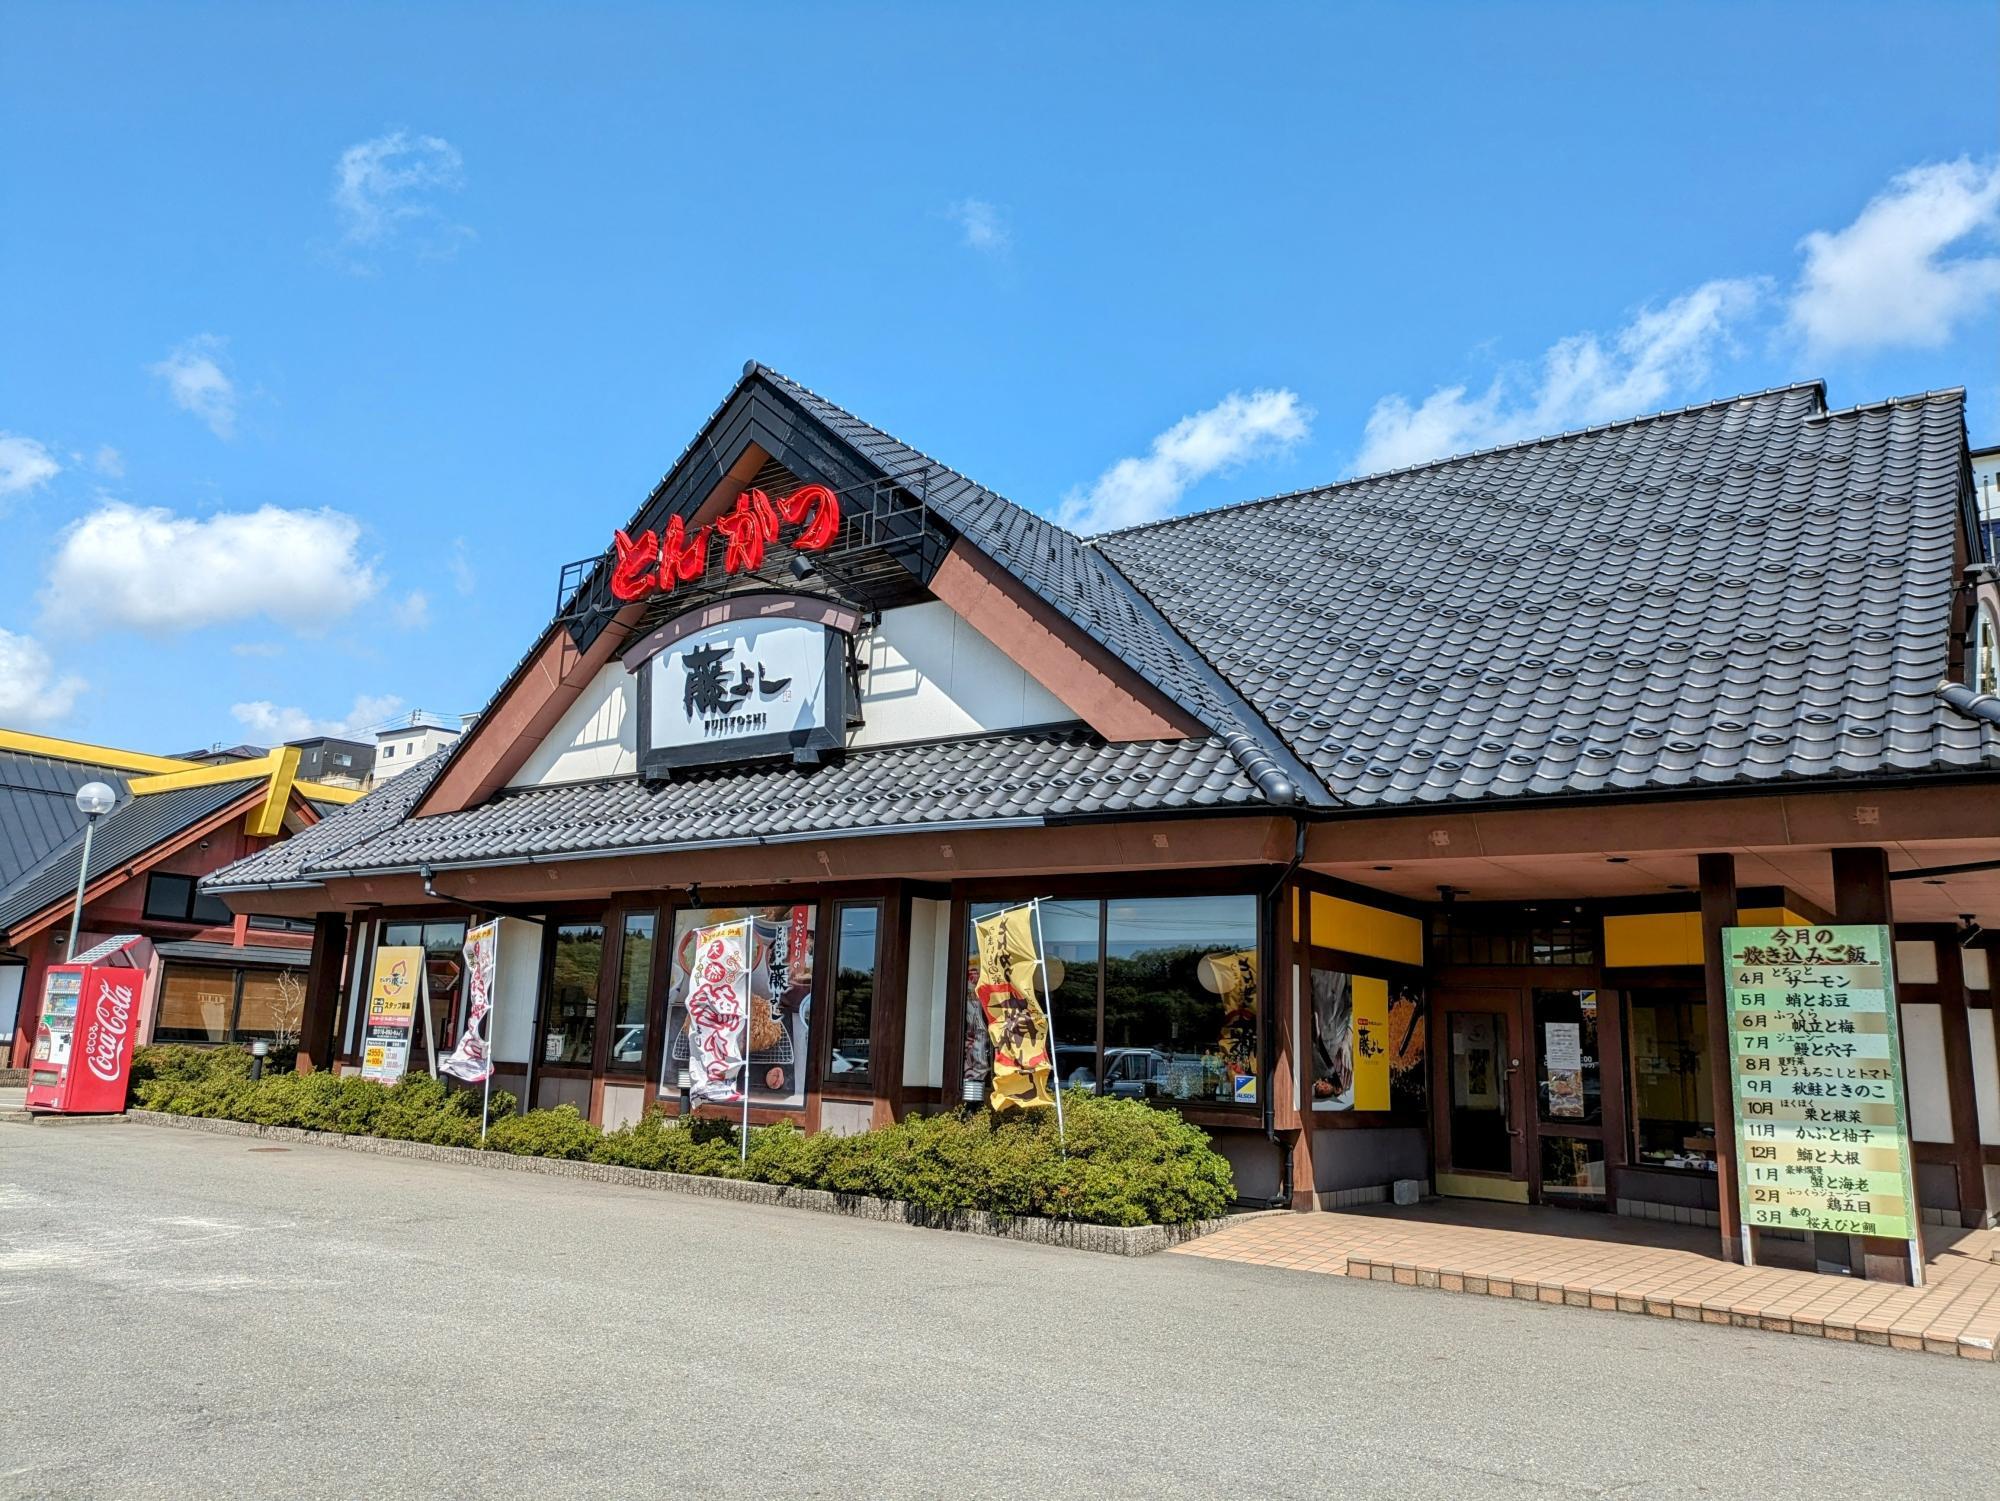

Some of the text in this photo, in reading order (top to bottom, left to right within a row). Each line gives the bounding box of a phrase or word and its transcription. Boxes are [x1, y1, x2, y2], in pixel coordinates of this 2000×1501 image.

[612, 483, 840, 601] とんかつ
[682, 643, 793, 719] 藤よし
[704, 712, 767, 731] FUJIYOSHI
[793, 912, 807, 969] こだわりの
[1771, 928, 1834, 946] 今月の
[1744, 945, 1868, 964] 炊き込みご飯
[1739, 972, 1851, 988] 4月 サーモン
[1741, 994, 1766, 1006] 5月
[1774, 1009, 1818, 1019] ふっくら
[1743, 1015, 1856, 1034] 6月 帆立と梅
[1744, 1036, 1857, 1057] 7月 鰻と穴子
[1746, 1058, 1892, 1080] 8月 とうもろこしとトマト
[1777, 1057, 1805, 1066] 夏野菜
[1747, 1080, 1886, 1098] 9月 秋鮭ときのこ
[1748, 1102, 1862, 1123] 10月 栗と根菜
[1781, 1099, 1814, 1108] ほくほく
[1749, 1124, 1875, 1143] 11月 かぶと柚子
[1751, 1146, 1776, 1160] 12月
[1755, 1168, 1869, 1192] 1月 蟹と海老
[1754, 1189, 1871, 1214] 2月 鶏五目
[1789, 1207, 1811, 1218] 春の
[1756, 1210, 1876, 1235] 3月 桜えびと鯛
